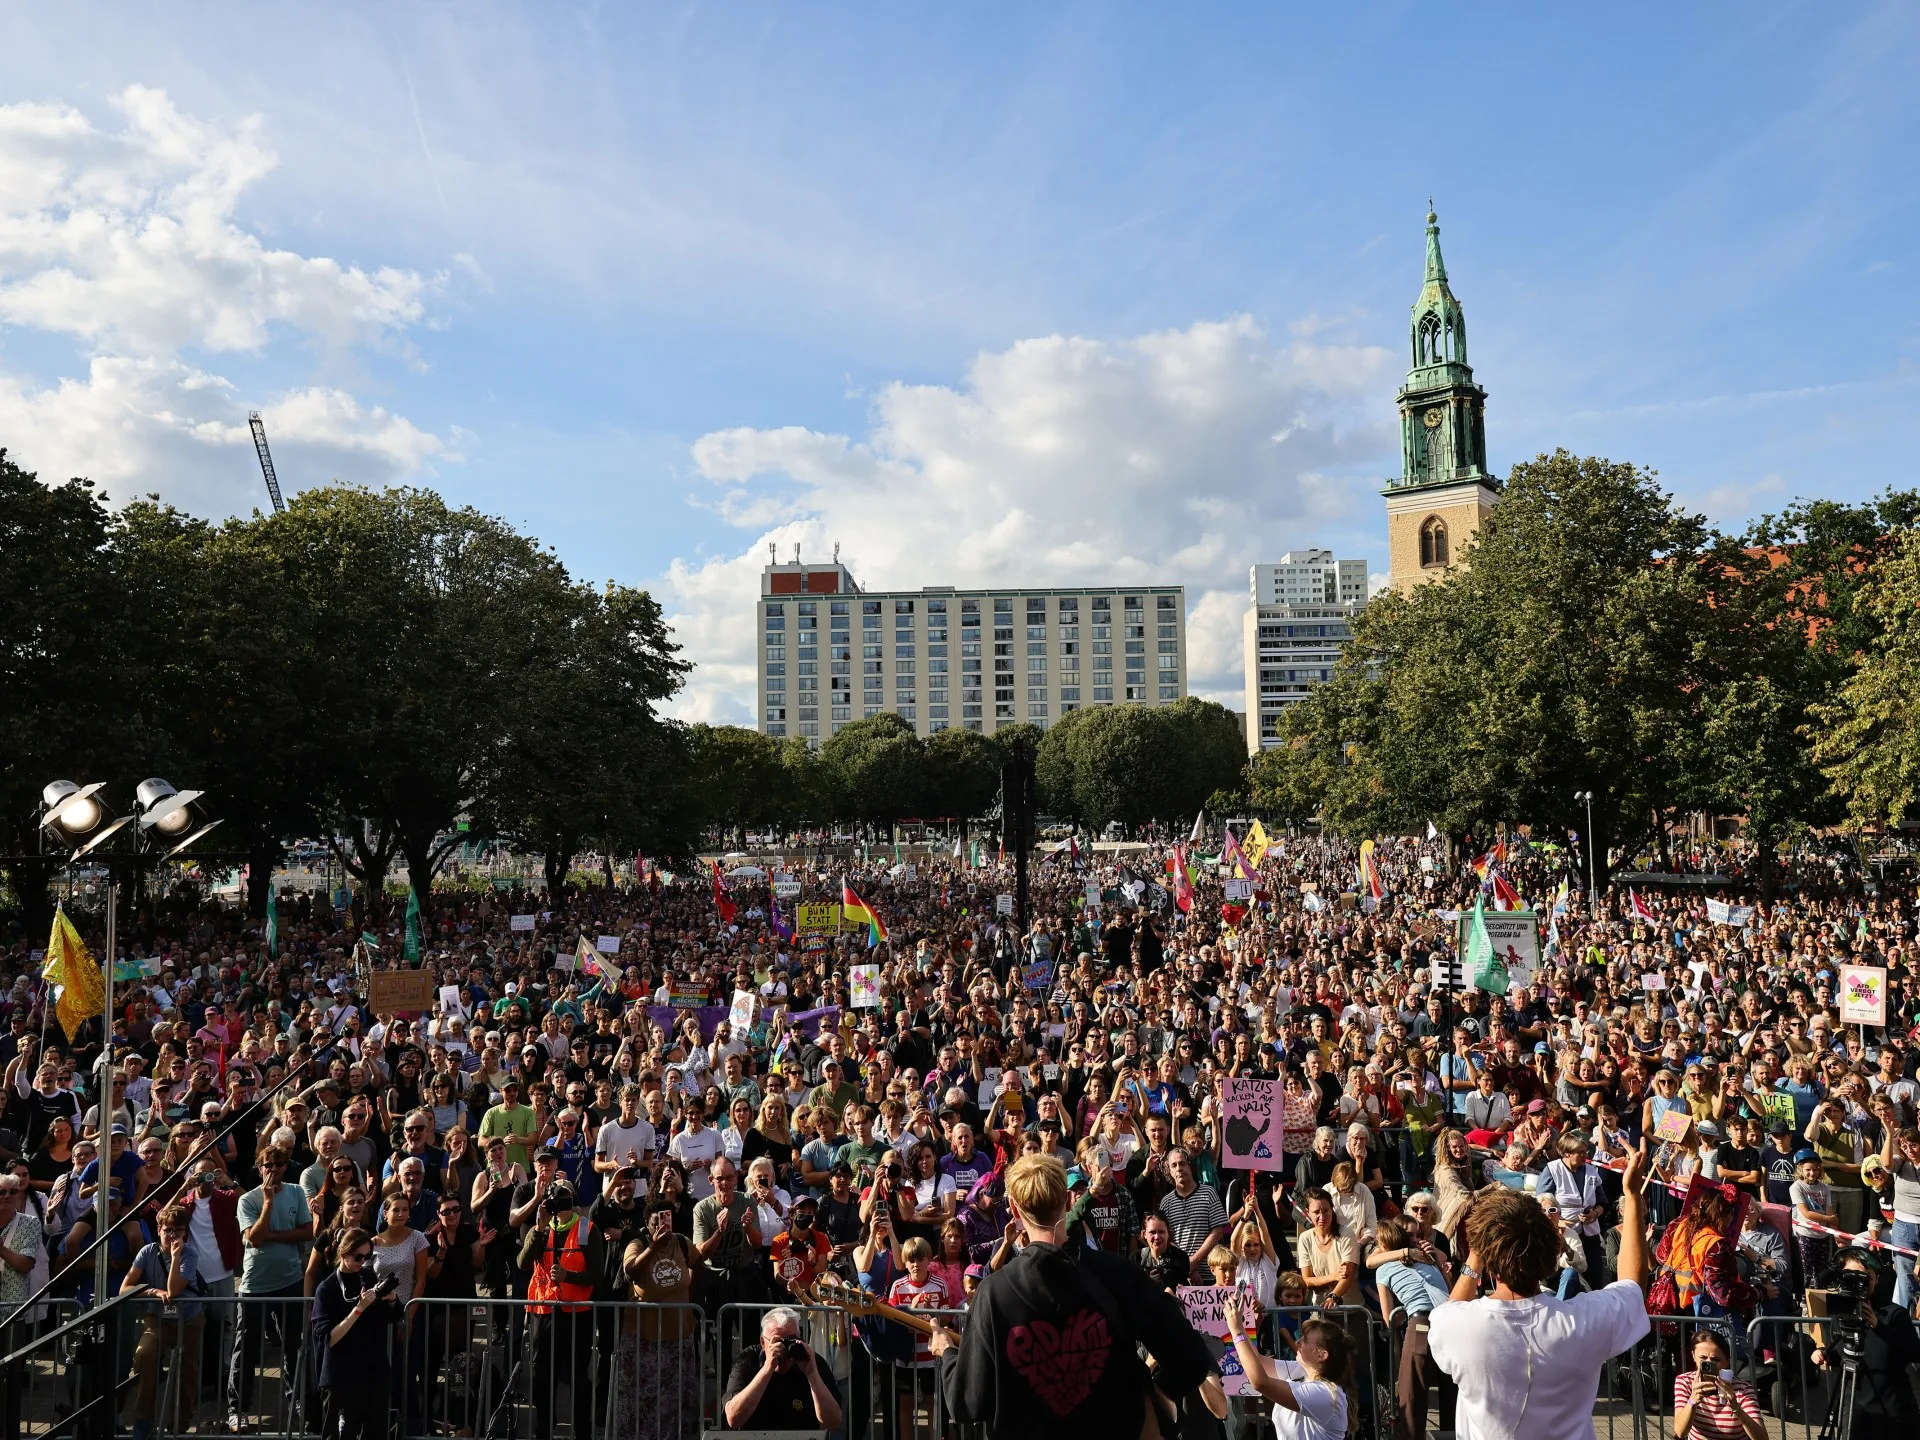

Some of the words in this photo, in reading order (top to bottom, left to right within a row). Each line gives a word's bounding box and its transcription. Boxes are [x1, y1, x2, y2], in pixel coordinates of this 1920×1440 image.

[808, 906, 830, 915] BUNT
[806, 916, 831, 925] STATT
[1231, 1079, 1273, 1094] KATZIS
[1225, 1092, 1255, 1103] KACKEN
[1259, 1094, 1275, 1103] AUF
[1238, 1101, 1271, 1116] NAZIS
[1777, 1106, 1793, 1116] STATT
[1659, 1129, 1678, 1140] NEIN
[1091, 1207, 1109, 1218] SSEN
[1110, 1207, 1119, 1217] IST
[1180, 1290, 1214, 1309] KATZIS
[1192, 1307, 1207, 1325] AUF
[1006, 1307, 1113, 1368] RADIKAL
